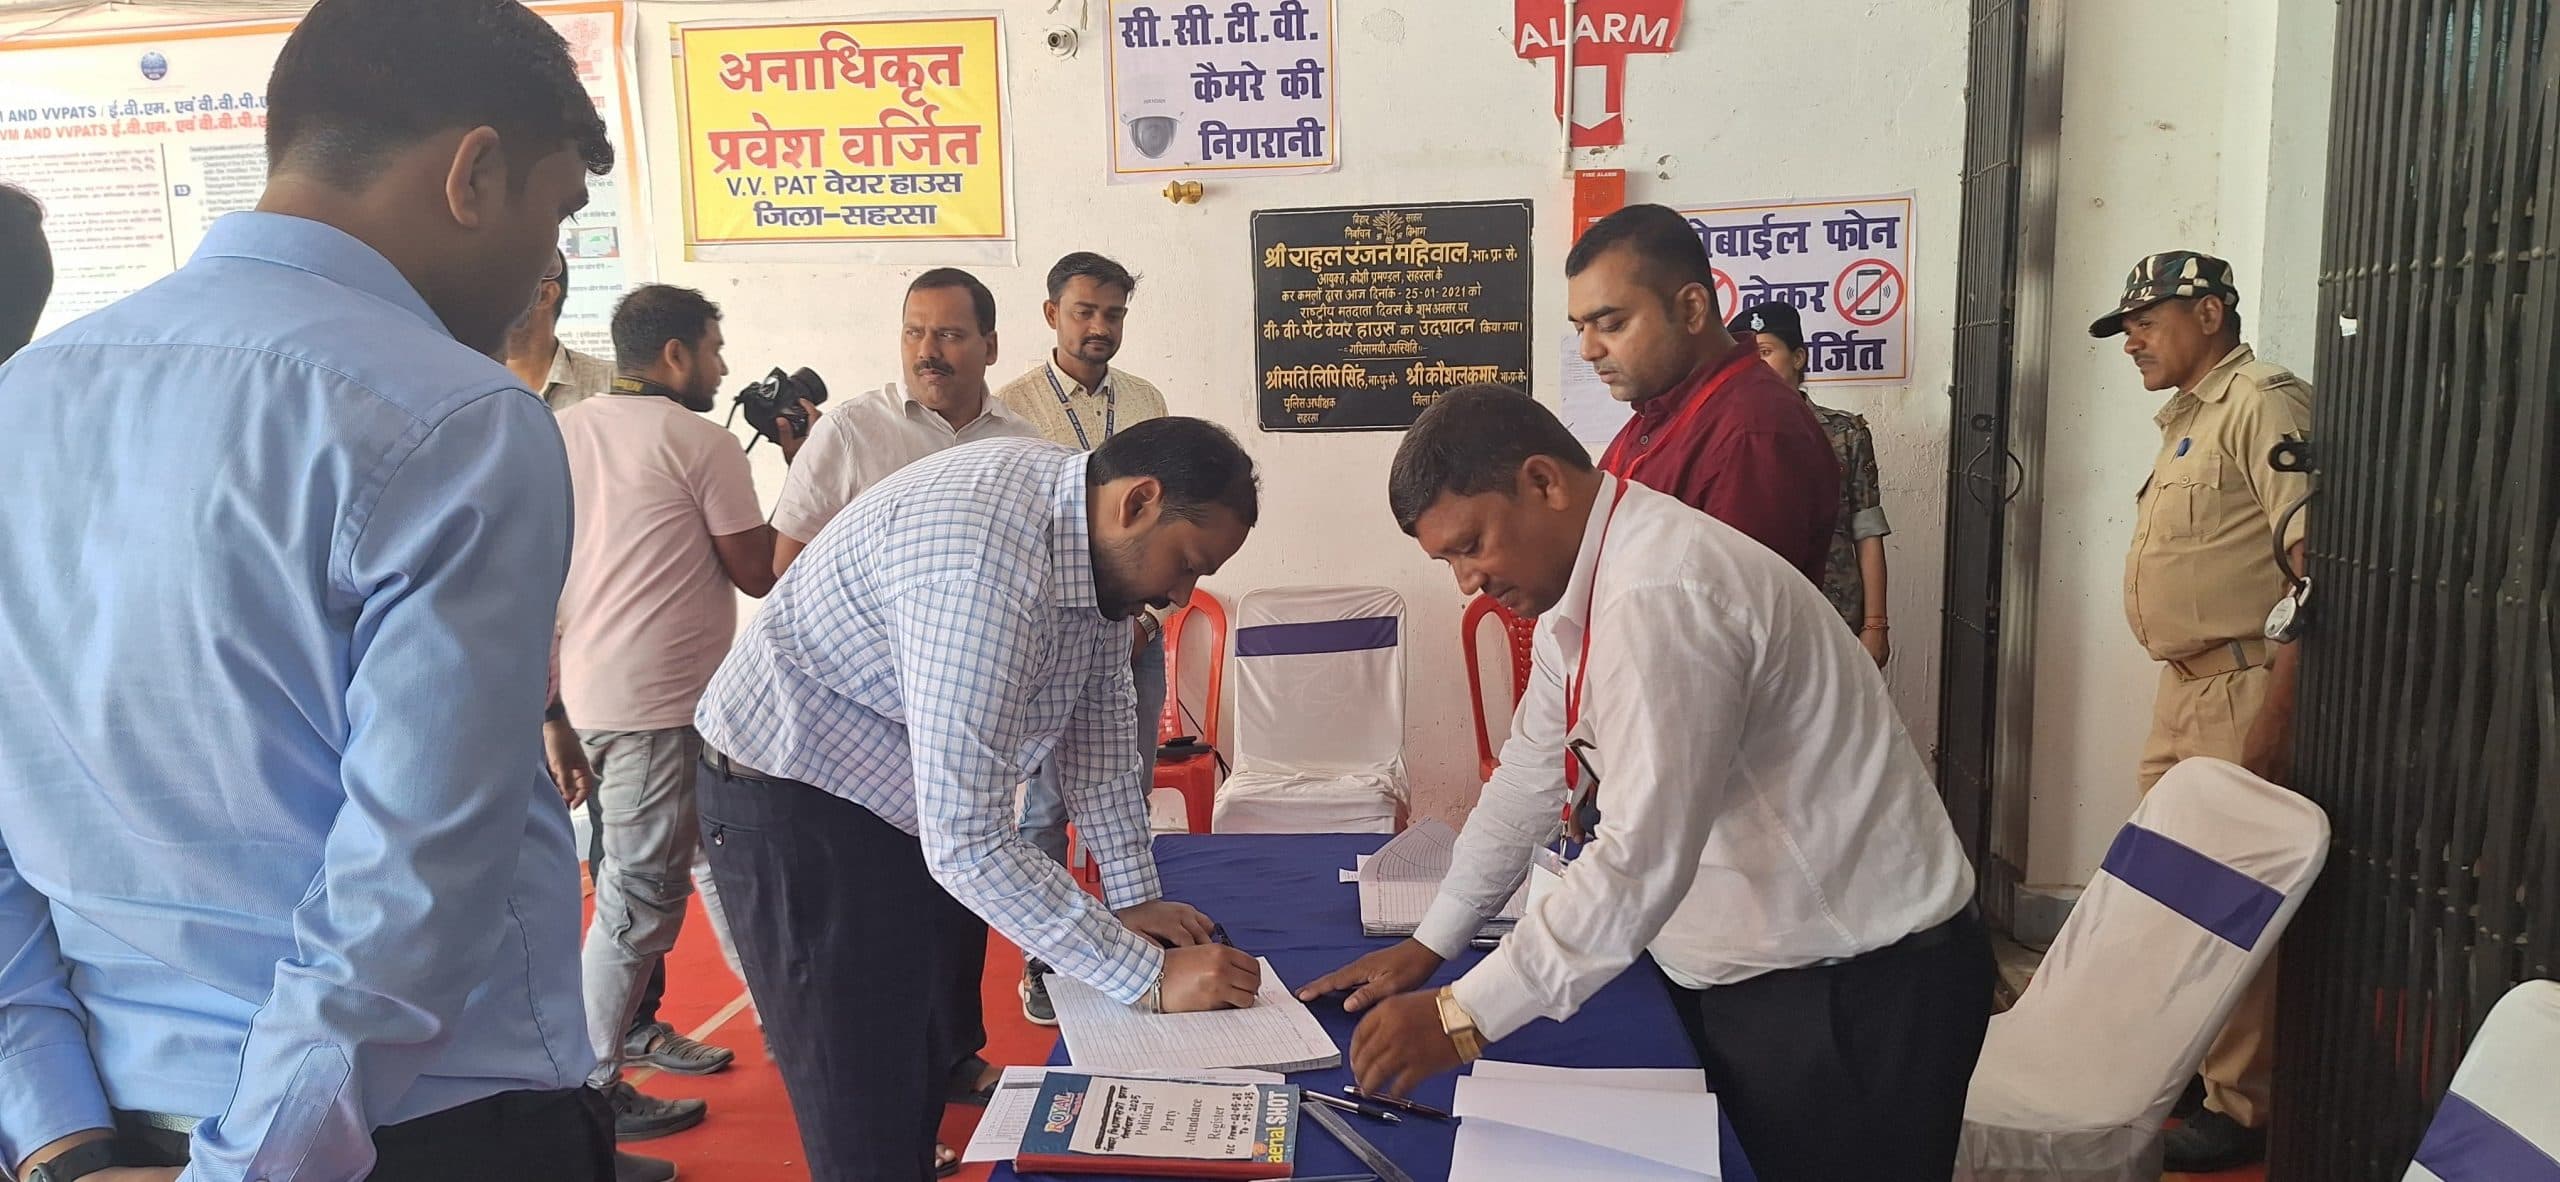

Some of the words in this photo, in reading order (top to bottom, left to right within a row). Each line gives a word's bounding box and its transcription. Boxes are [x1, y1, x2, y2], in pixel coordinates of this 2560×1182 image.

[1519, 13, 1669, 53] ALARM
[719, 30, 963, 107] अनाधिकृत
[1190, 61, 1266, 103] कैमरे
[1276, 59, 1324, 99] की
[8, 109, 37, 122] AND
[42, 104, 97, 120] VVPATS
[24, 127, 52, 140] AND
[56, 123, 108, 138] VVPATS
[708, 112, 824, 174] प्रवेश
[839, 104, 981, 166] वर्जित
[1198, 117, 1325, 160] निगरानी
[727, 177, 766, 196] V.V.
[775, 176, 816, 195] PAT
[824, 170, 885, 194] वेयर
[889, 173, 962, 194] हाउस
[1689, 213, 1811, 260] ोबाईल
[1822, 209, 1900, 251] फोन
[1264, 242, 1286, 268] श्री
[1288, 246, 1343, 273] राहुल
[1344, 240, 1394, 265] रंजन
[1281, 290, 1295, 302] कर
[1325, 289, 1343, 302] द्वारा
[1344, 289, 1366, 301] आज
[1467, 281, 1483, 296] को
[1739, 275, 1829, 312] लेकर
[1300, 303, 1335, 320] राष्ट्रीय
[1338, 305, 1373, 318] मतदाता
[1375, 301, 1403, 317] दिवस
[1404, 300, 1415, 315] के
[1458, 302, 1468, 313] पर
[1325, 319, 1353, 338] वेयर
[1355, 321, 1396, 339] हाउस
[1399, 324, 1415, 336] का
[1480, 319, 1501, 334] किया
[1803, 330, 1887, 372] र्जित
[1310, 364, 1341, 388] लिपि
[1406, 362, 1424, 386] श्री
[1044, 1092, 1075, 1133] ROYAL
[1135, 1102, 1154, 1136] Political
[1160, 1109, 1180, 1132] Party
[1184, 1099, 1202, 1145] Attendance
[1208, 1105, 1225, 1140] Register
[1265, 1091, 1290, 1125] SHOT
[1266, 1127, 1286, 1163] aerial
